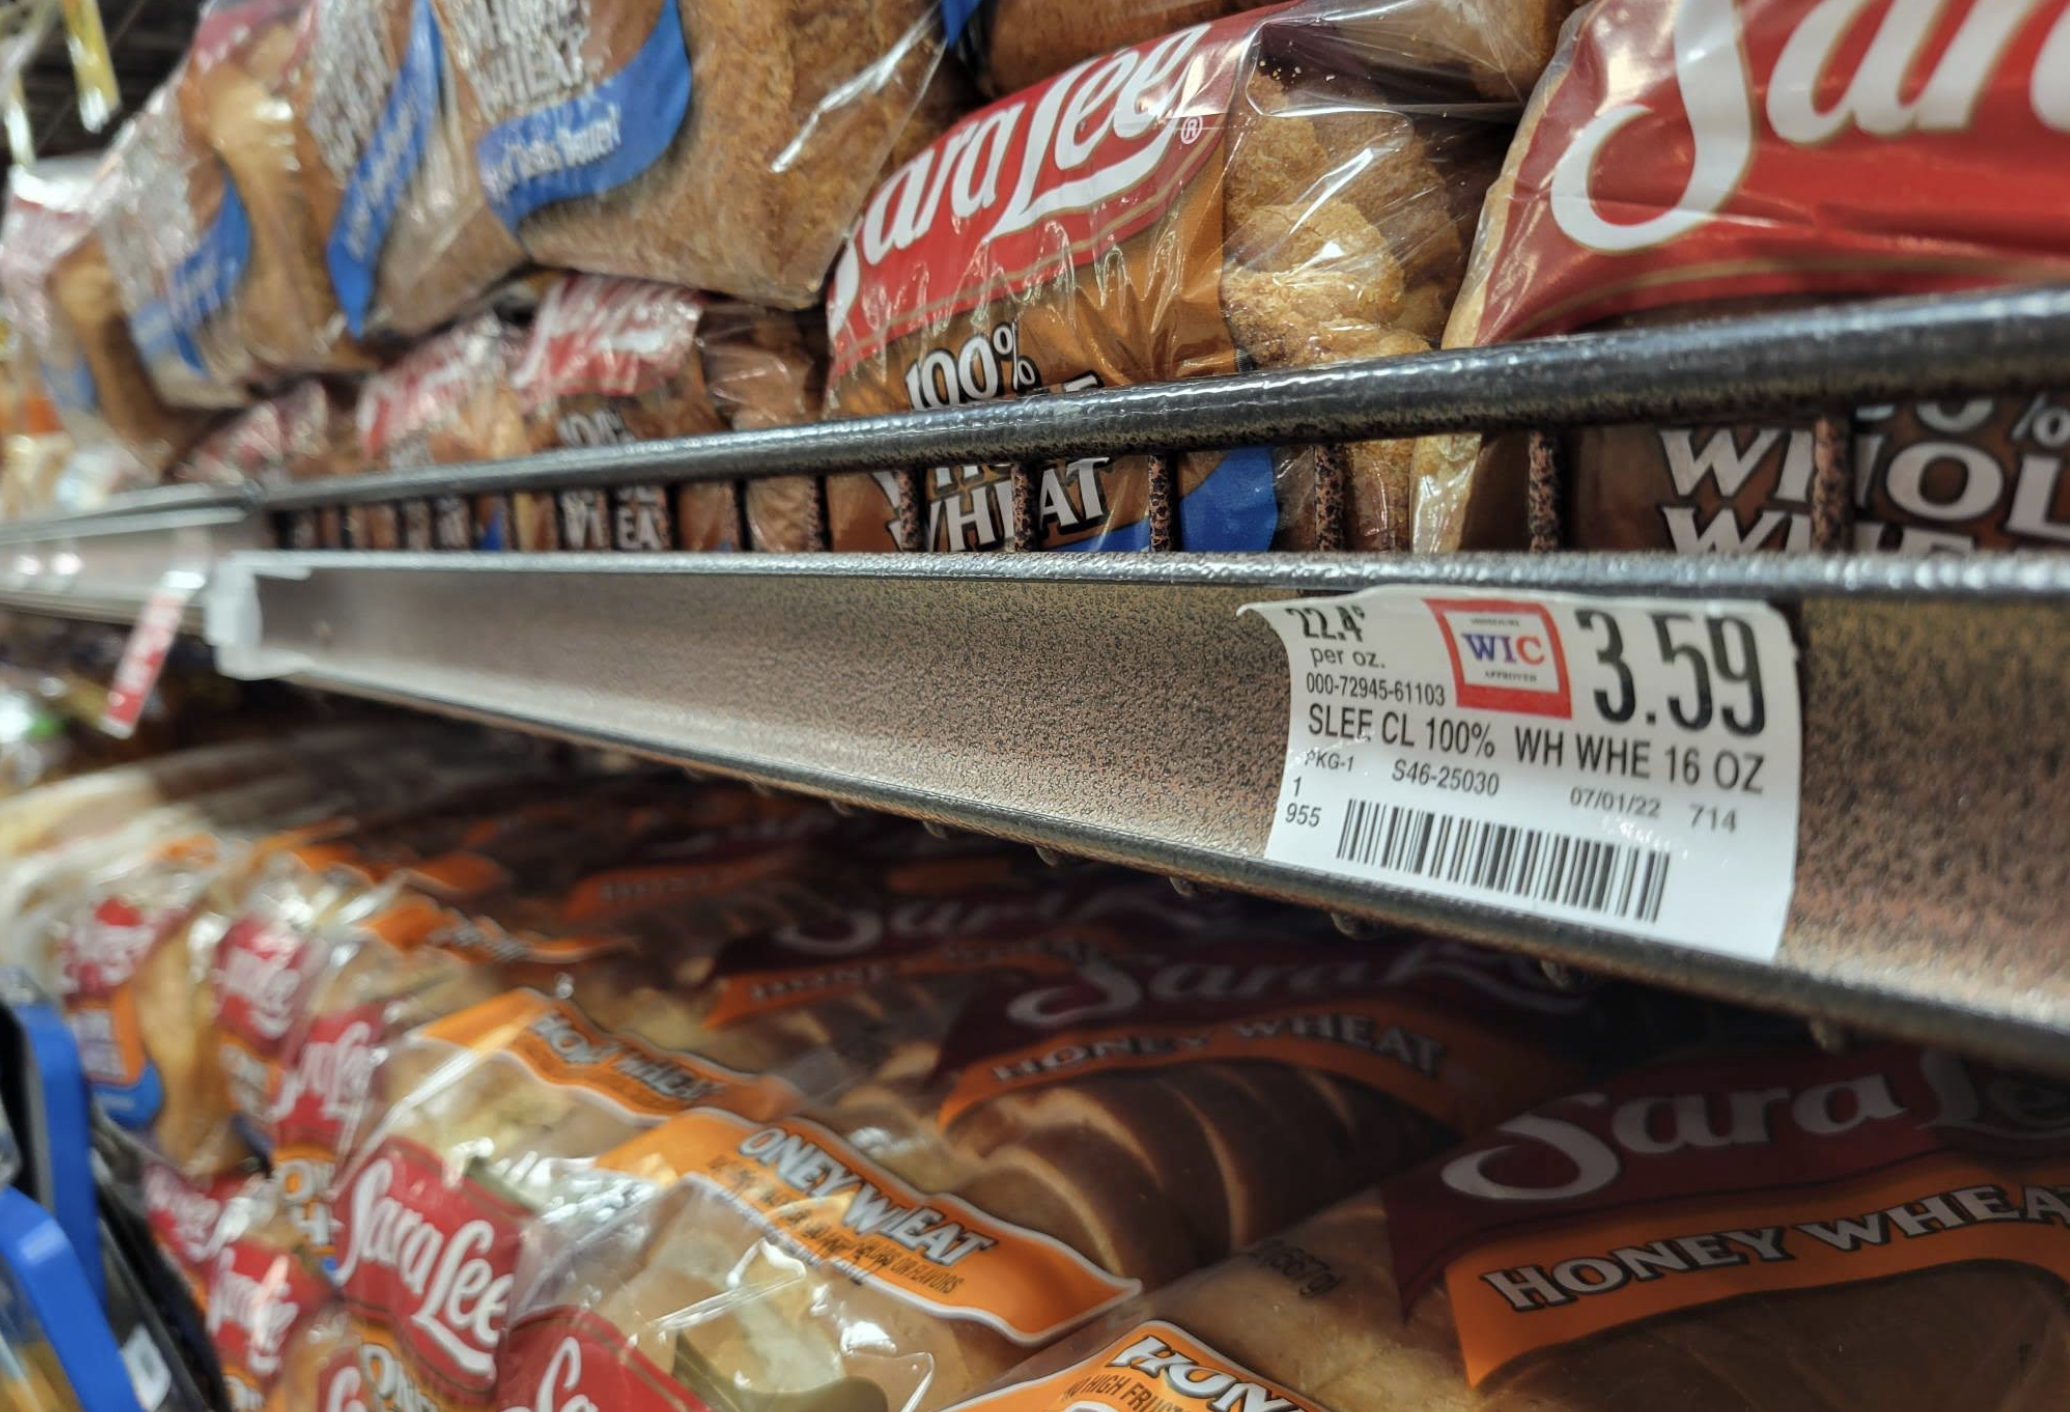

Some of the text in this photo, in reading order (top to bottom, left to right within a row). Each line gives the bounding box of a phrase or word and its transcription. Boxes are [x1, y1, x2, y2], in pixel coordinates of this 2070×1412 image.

[985, 22, 1212, 240] Lee
[905, 322, 1036, 411] 100%
[1310, 646, 1387, 669] per oz.
[1461, 632, 1546, 666] WIC
[1574, 608, 1767, 738] 3.59
[1306, 672, 1446, 708] 000-72945-61103
[1382, 711, 1416, 748] CL
[1426, 716, 1496, 760] 100%
[1515, 725, 1565, 769] WH
[1576, 732, 1651, 780] WHE
[1664, 745, 1701, 786] 16
[1713, 749, 1765, 795] OZ
[1391, 758, 1500, 797] S46-25030
[1285, 802, 1322, 828] 955
[1293, 776, 1302, 798] 1
[1570, 786, 1738, 834] 07/01/22 714
[990, 1013, 1448, 1084] HONEY WHEAT
[1440, 1070, 1909, 1201] Sara
[335, 1157, 445, 1296] Sara
[410, 1218, 515, 1378] Lee
[1480, 1183, 2070, 1313] HONEY WHEA
[1082, 1373, 1131, 1396] HIGH
